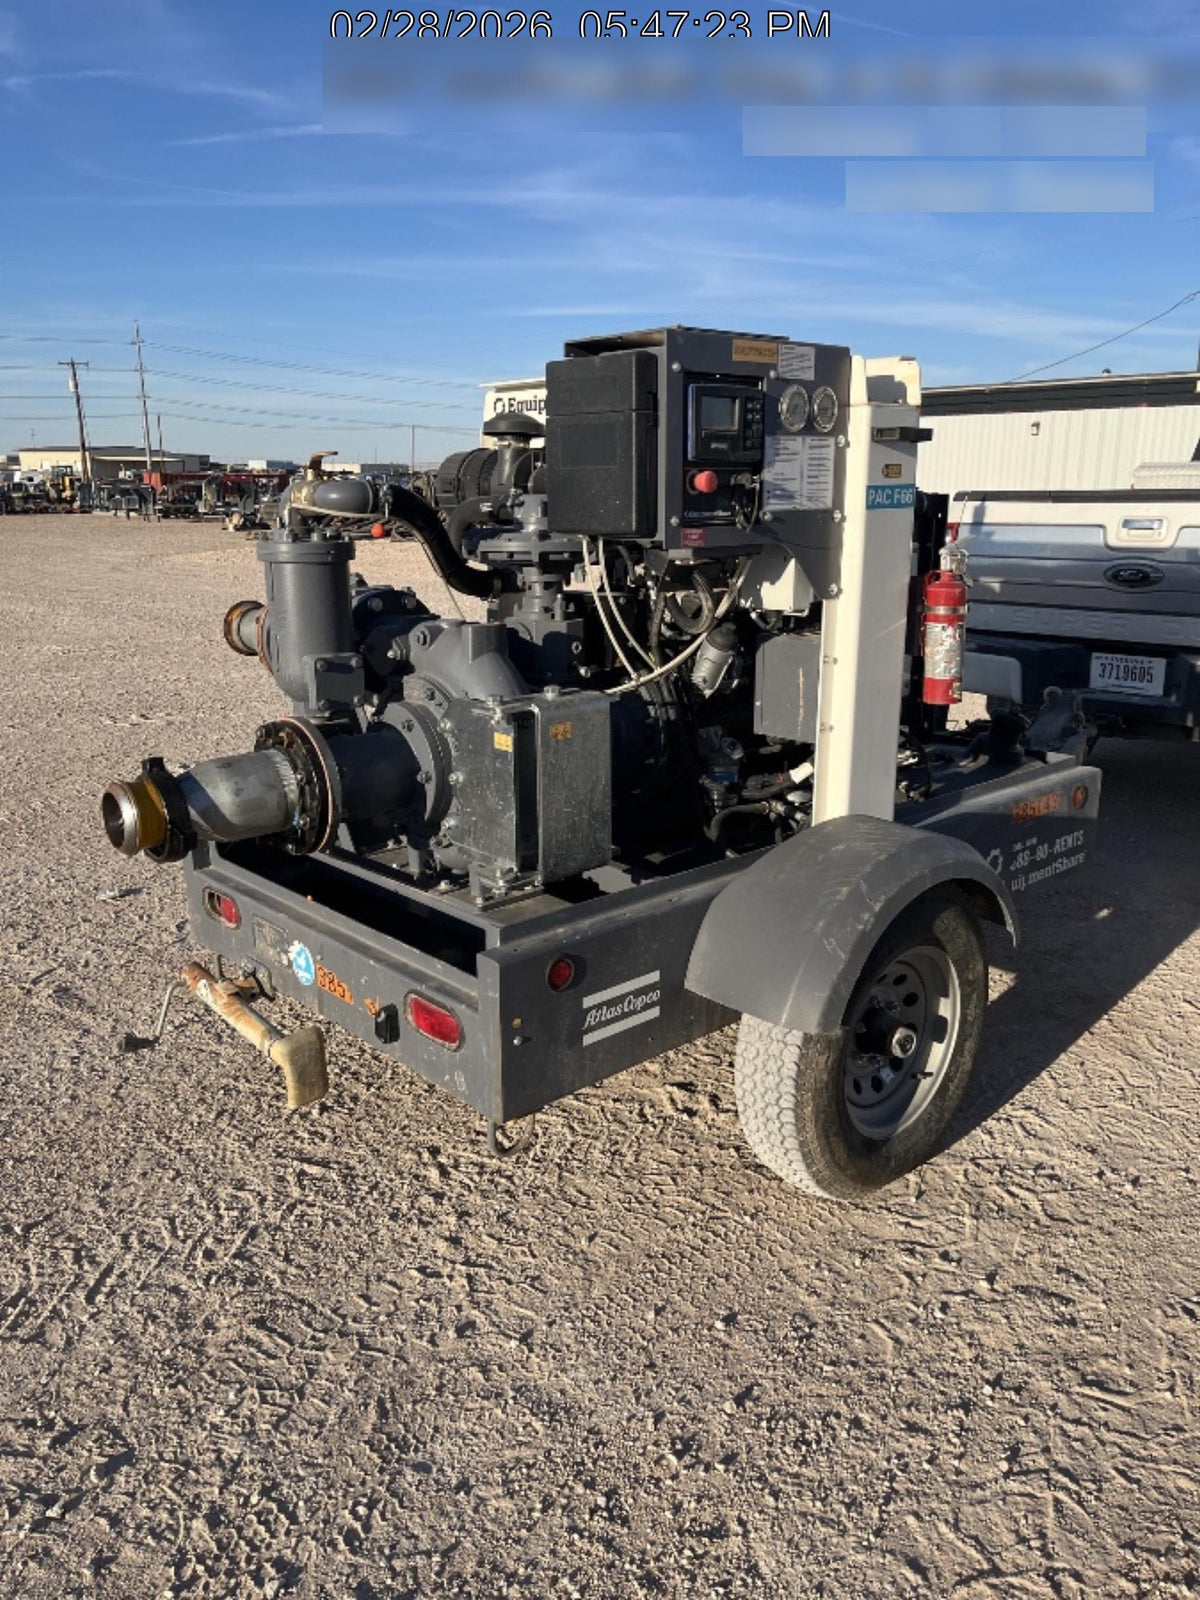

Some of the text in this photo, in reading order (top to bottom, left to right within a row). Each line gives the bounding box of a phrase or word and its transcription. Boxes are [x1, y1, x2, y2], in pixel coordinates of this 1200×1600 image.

[868, 487, 913, 506] PAC F66
[1098, 662, 1154, 684] 3719605
[582, 989, 660, 1030] Atlas Copco
